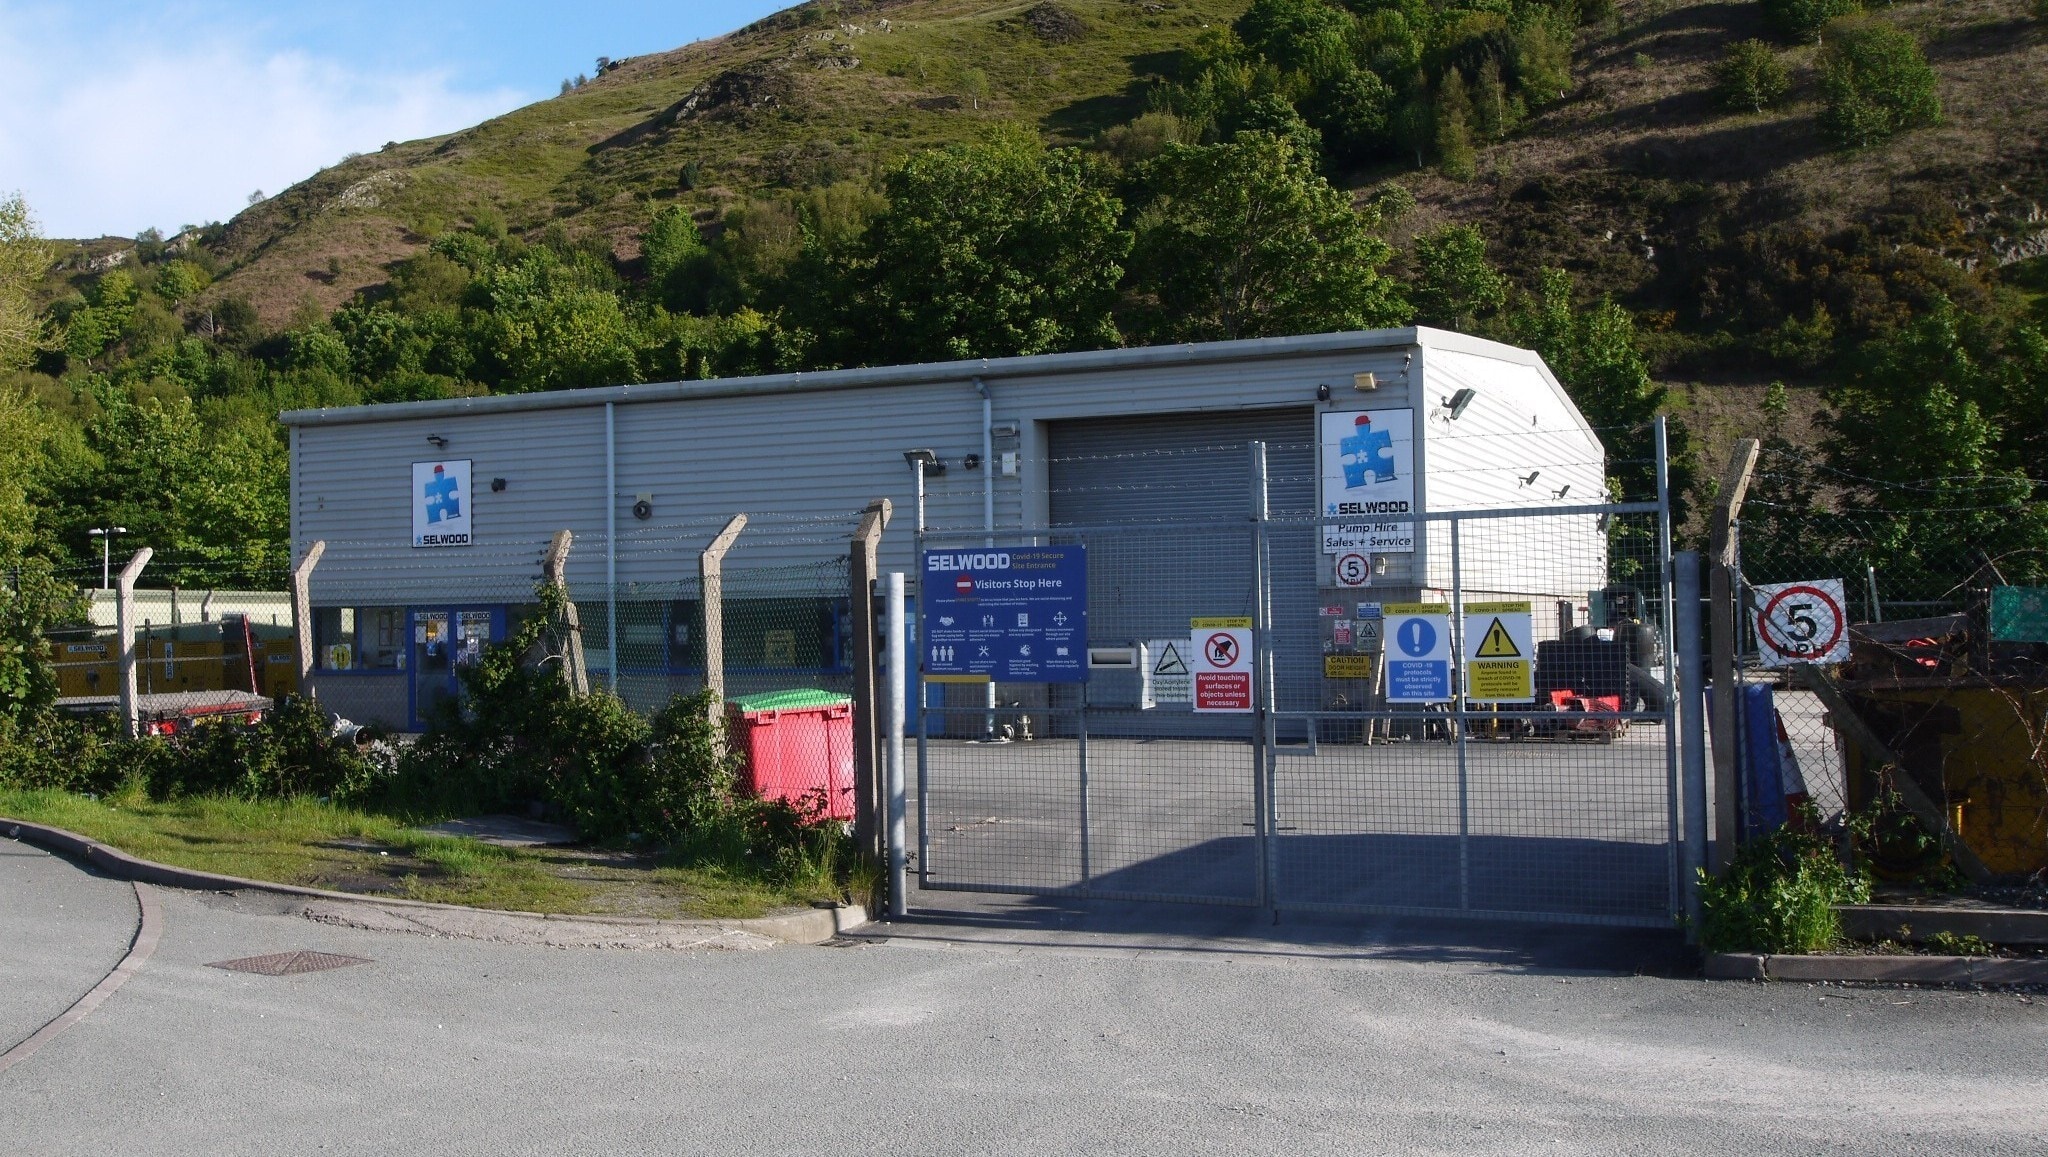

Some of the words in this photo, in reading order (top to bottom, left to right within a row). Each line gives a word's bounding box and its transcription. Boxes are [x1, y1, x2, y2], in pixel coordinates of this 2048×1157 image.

[1338, 501, 1409, 515] SELWOOD
[1338, 523, 1370, 535] Pump
[1374, 522, 1398, 532] Hire
[423, 534, 469, 545] SELWOOD
[1326, 538, 1354, 547] Sales
[1358, 539, 1366, 547] +
[1369, 535, 1411, 546] Service
[928, 553, 1011, 571] SELWOOD
[1347, 561, 1360, 577] 5
[975, 580, 1012, 589] Visitors
[1014, 578, 1036, 590] Stop
[1038, 578, 1062, 588] Here
[1787, 604, 1817, 641] 5
[1217, 674, 1246, 683] touching
[1420, 676, 1441, 684] strictly
[1200, 690, 1224, 699] objects
[1206, 699, 1240, 707] necessary
